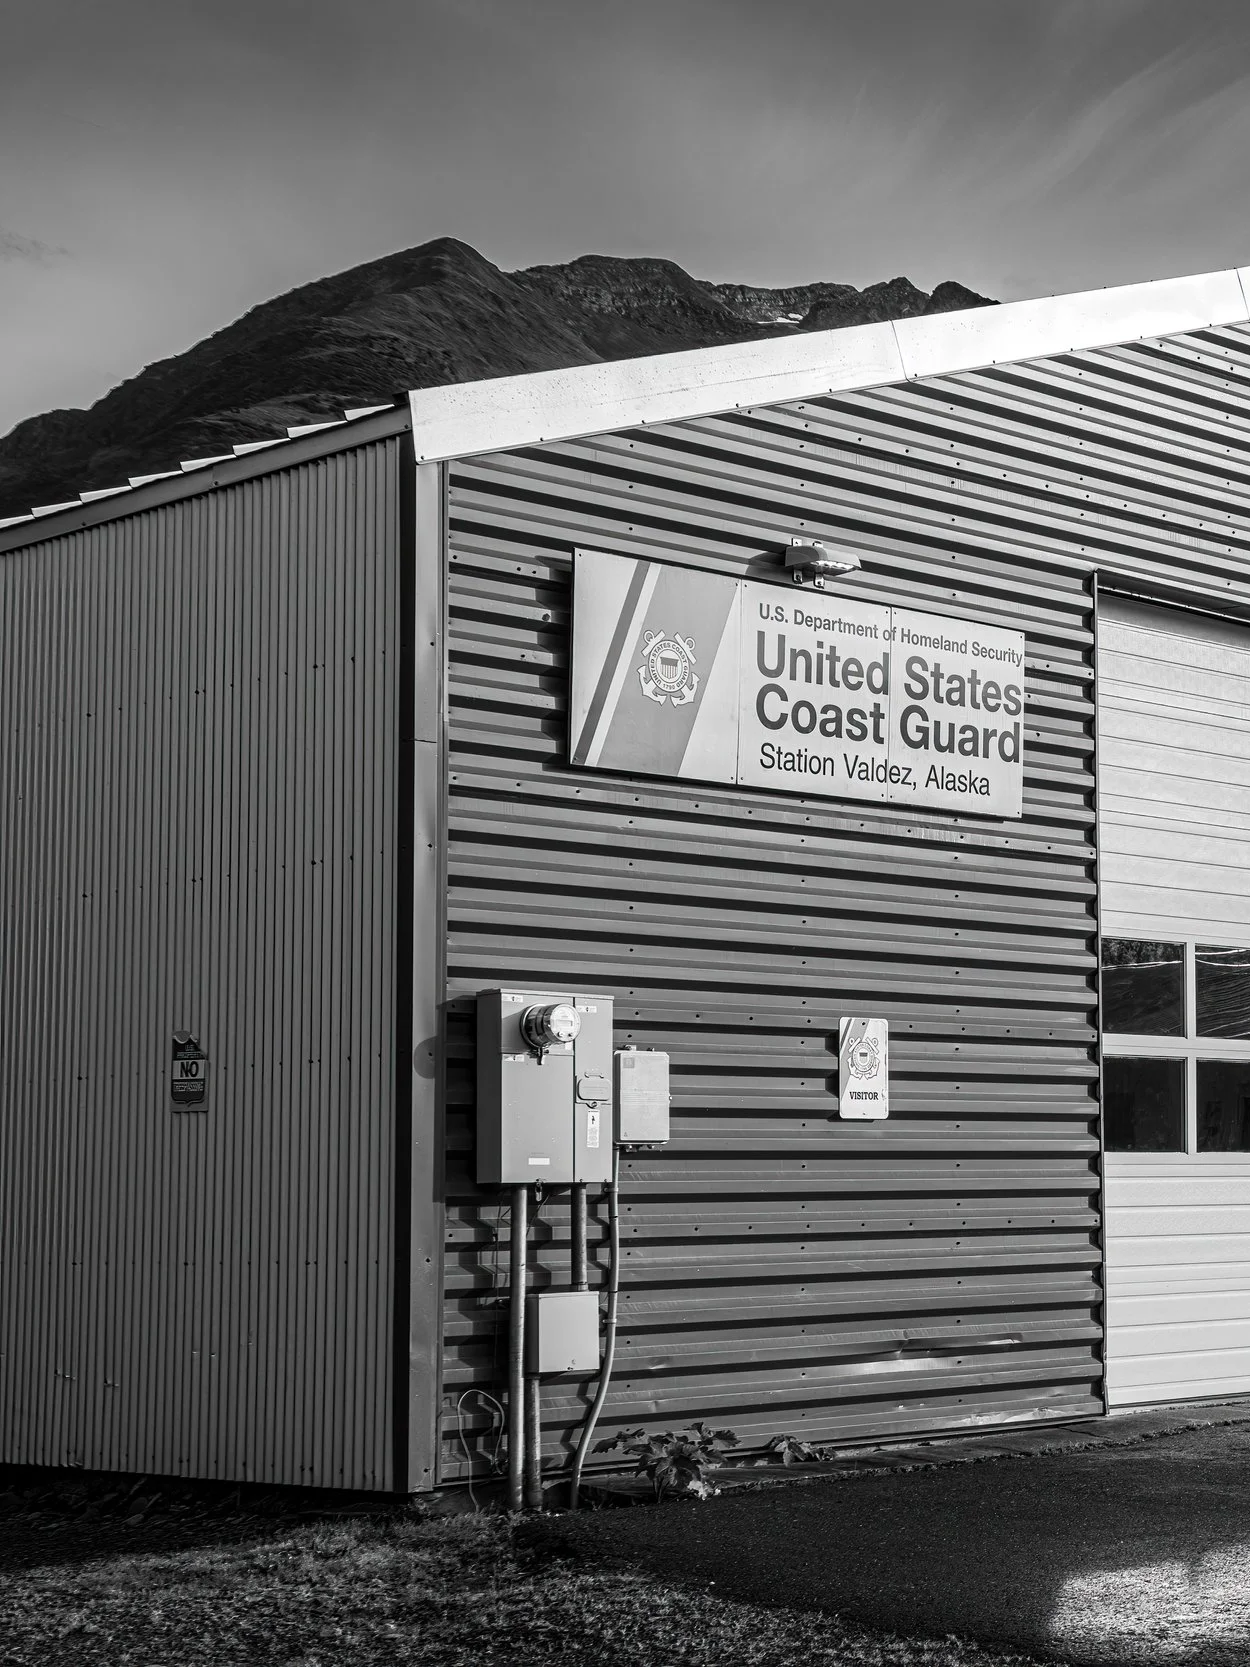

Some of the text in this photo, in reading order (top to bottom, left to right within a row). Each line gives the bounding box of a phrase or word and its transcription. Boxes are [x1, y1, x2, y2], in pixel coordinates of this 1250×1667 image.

[760, 603, 1022, 667] U.S. Department of Homeland Security
[652, 642, 671, 658] STATES
[672, 644, 687, 664] COAST
[650, 658, 662, 685] UNITED
[757, 630, 1021, 716] United States
[756, 683, 1020, 763] Coast Guard
[760, 742, 990, 796] Station Valdez, Alaska
[180, 1061, 199, 1078] NO
[849, 1091, 879, 1100] VISITOR
